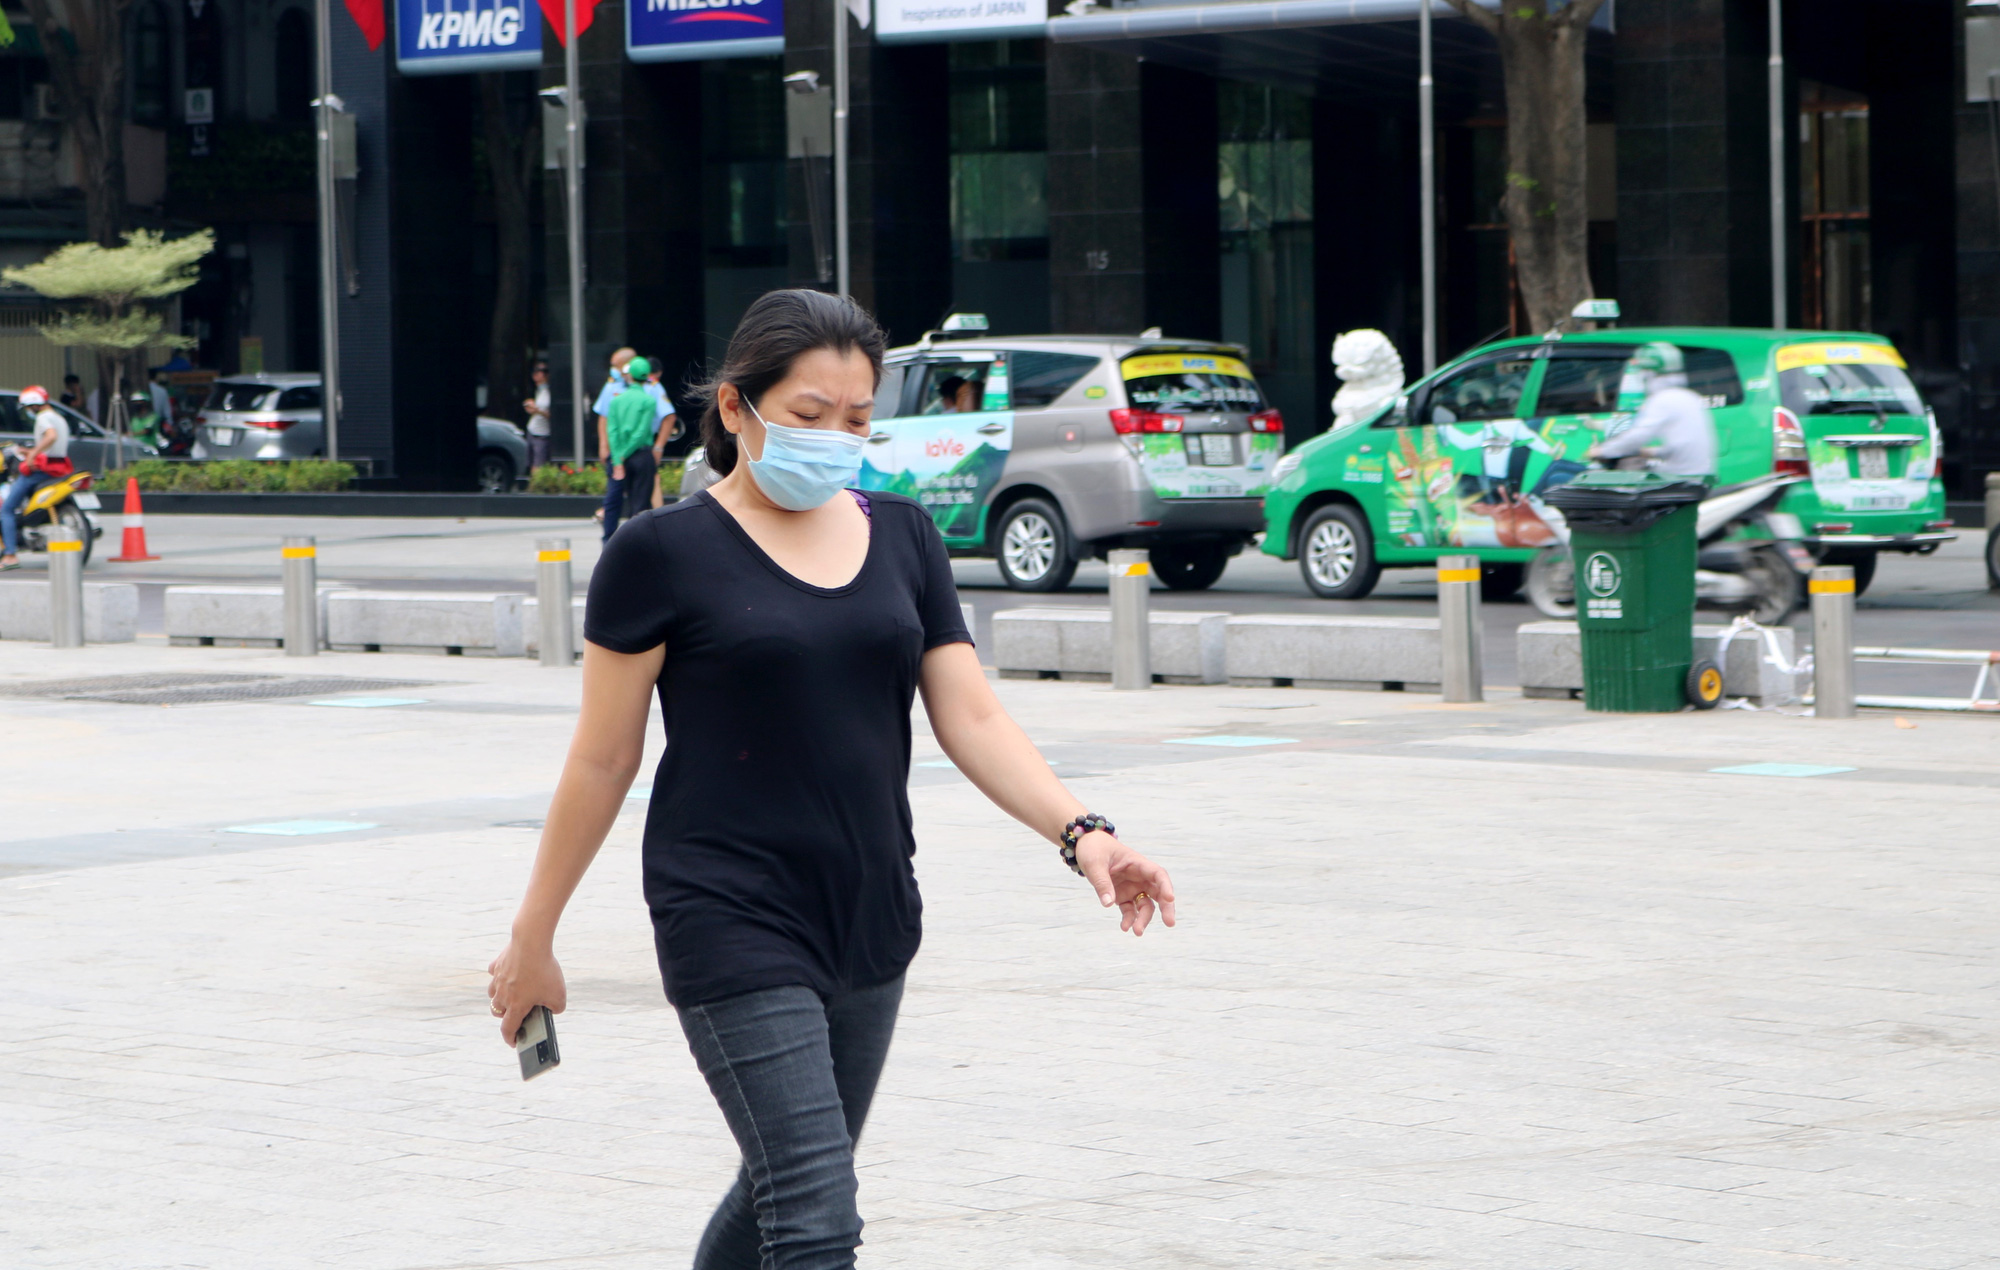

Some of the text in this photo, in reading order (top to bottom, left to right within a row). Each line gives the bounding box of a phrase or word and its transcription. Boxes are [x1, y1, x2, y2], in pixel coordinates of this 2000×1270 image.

[417, 6, 520, 50] KPMG
[901, 1, 1027, 24] Inspiration of JAPAN
